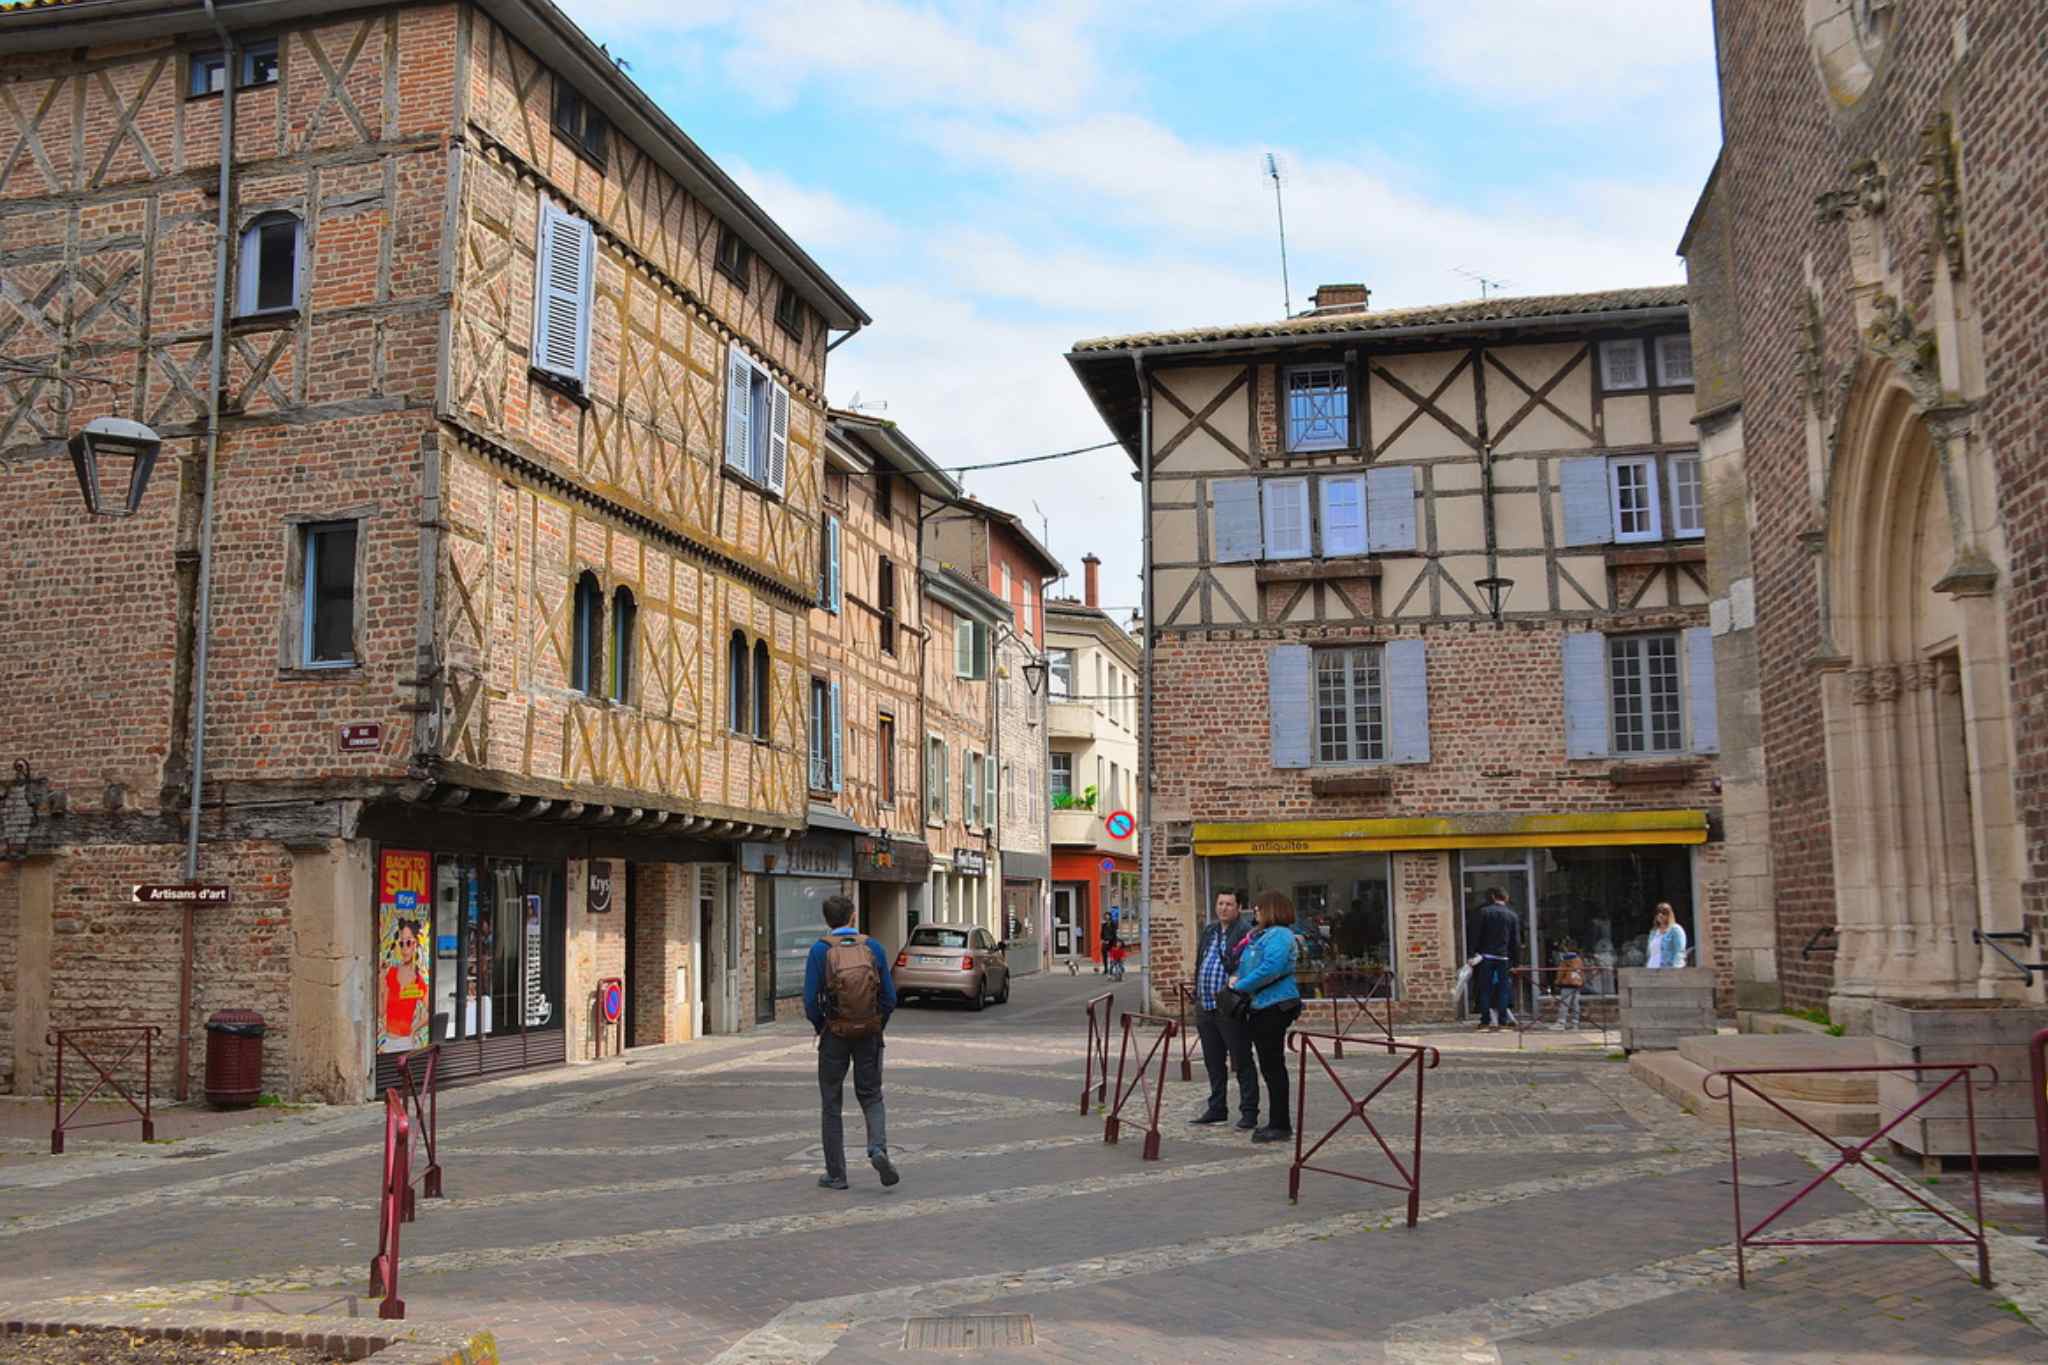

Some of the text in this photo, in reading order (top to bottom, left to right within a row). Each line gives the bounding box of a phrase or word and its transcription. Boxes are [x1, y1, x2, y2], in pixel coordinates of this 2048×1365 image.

[385, 855, 426, 870] BACK TO
[385, 869, 426, 896] SUN
[590, 874, 611, 896] Krys
[150, 888, 227, 899] Artisans d'art
